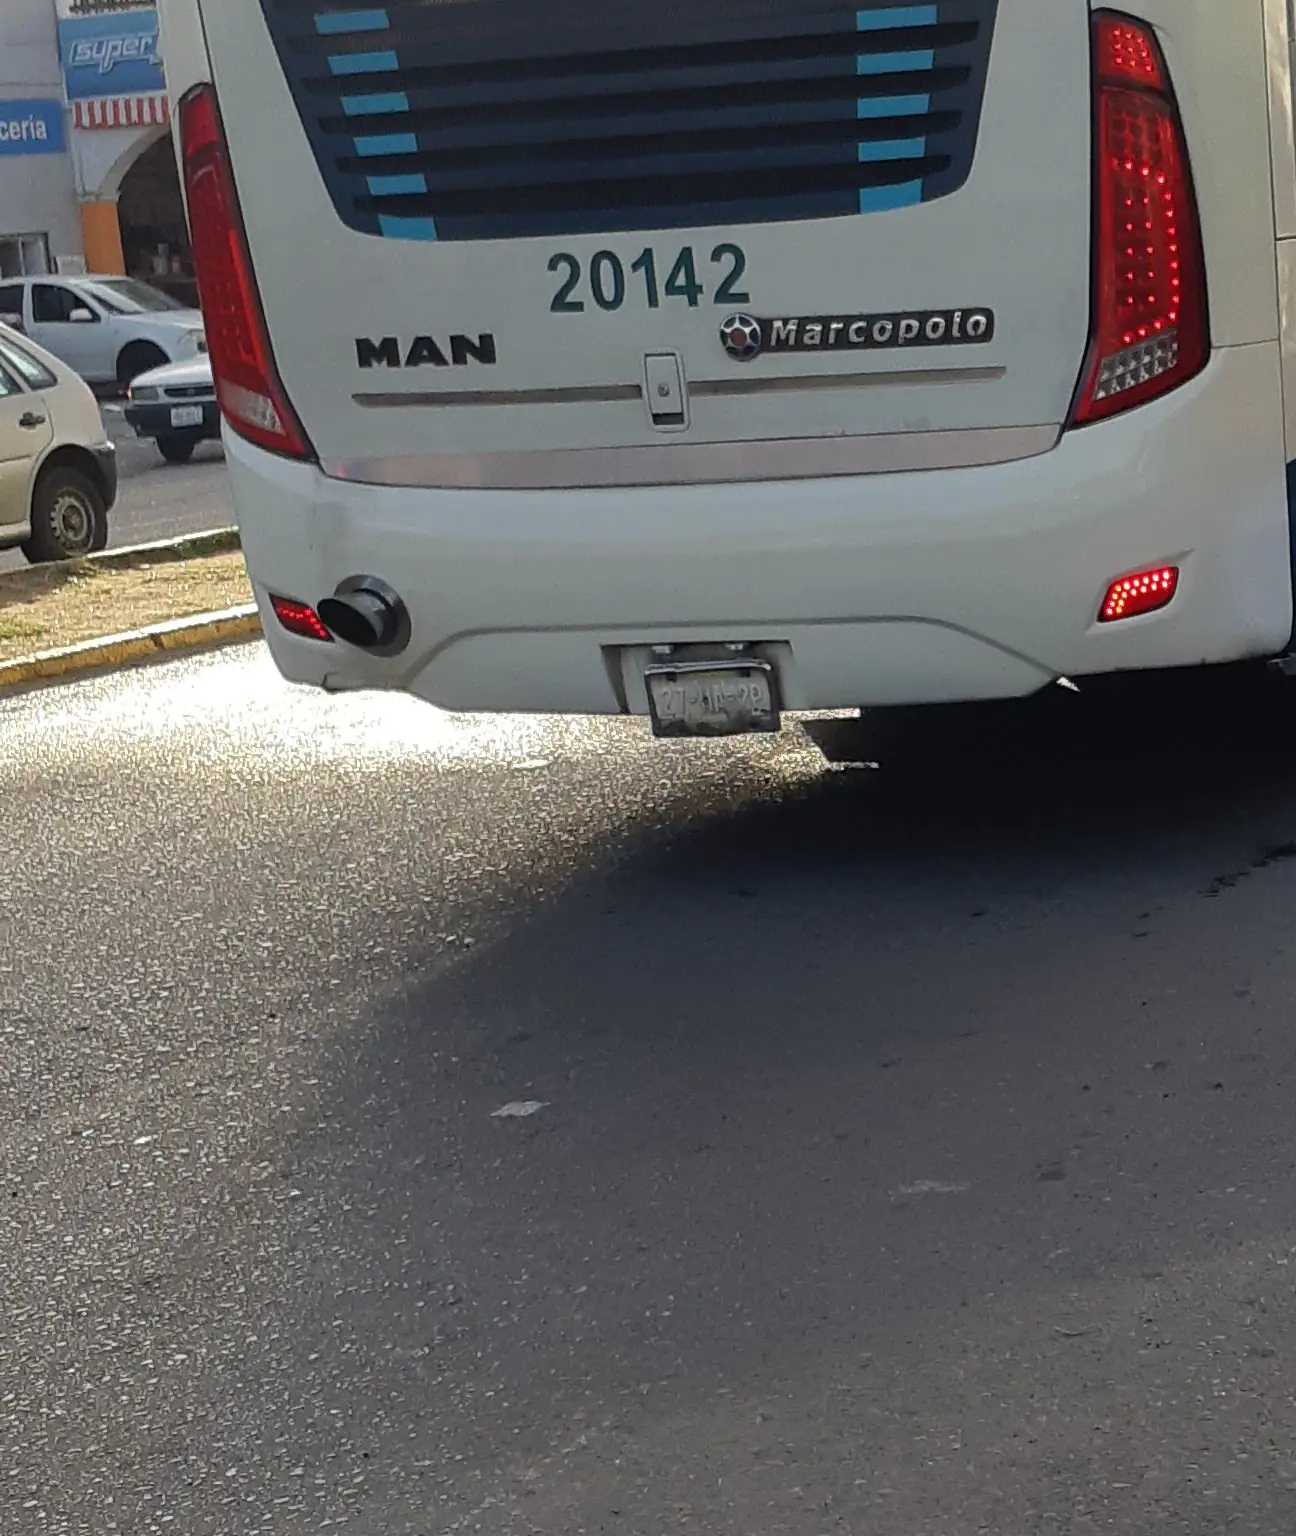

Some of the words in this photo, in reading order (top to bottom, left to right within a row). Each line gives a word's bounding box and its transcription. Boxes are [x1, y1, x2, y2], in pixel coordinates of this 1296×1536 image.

[547, 242, 750, 314] 20142
[770, 310, 988, 348] Marcopolo
[354, 332, 498, 369] MAN
